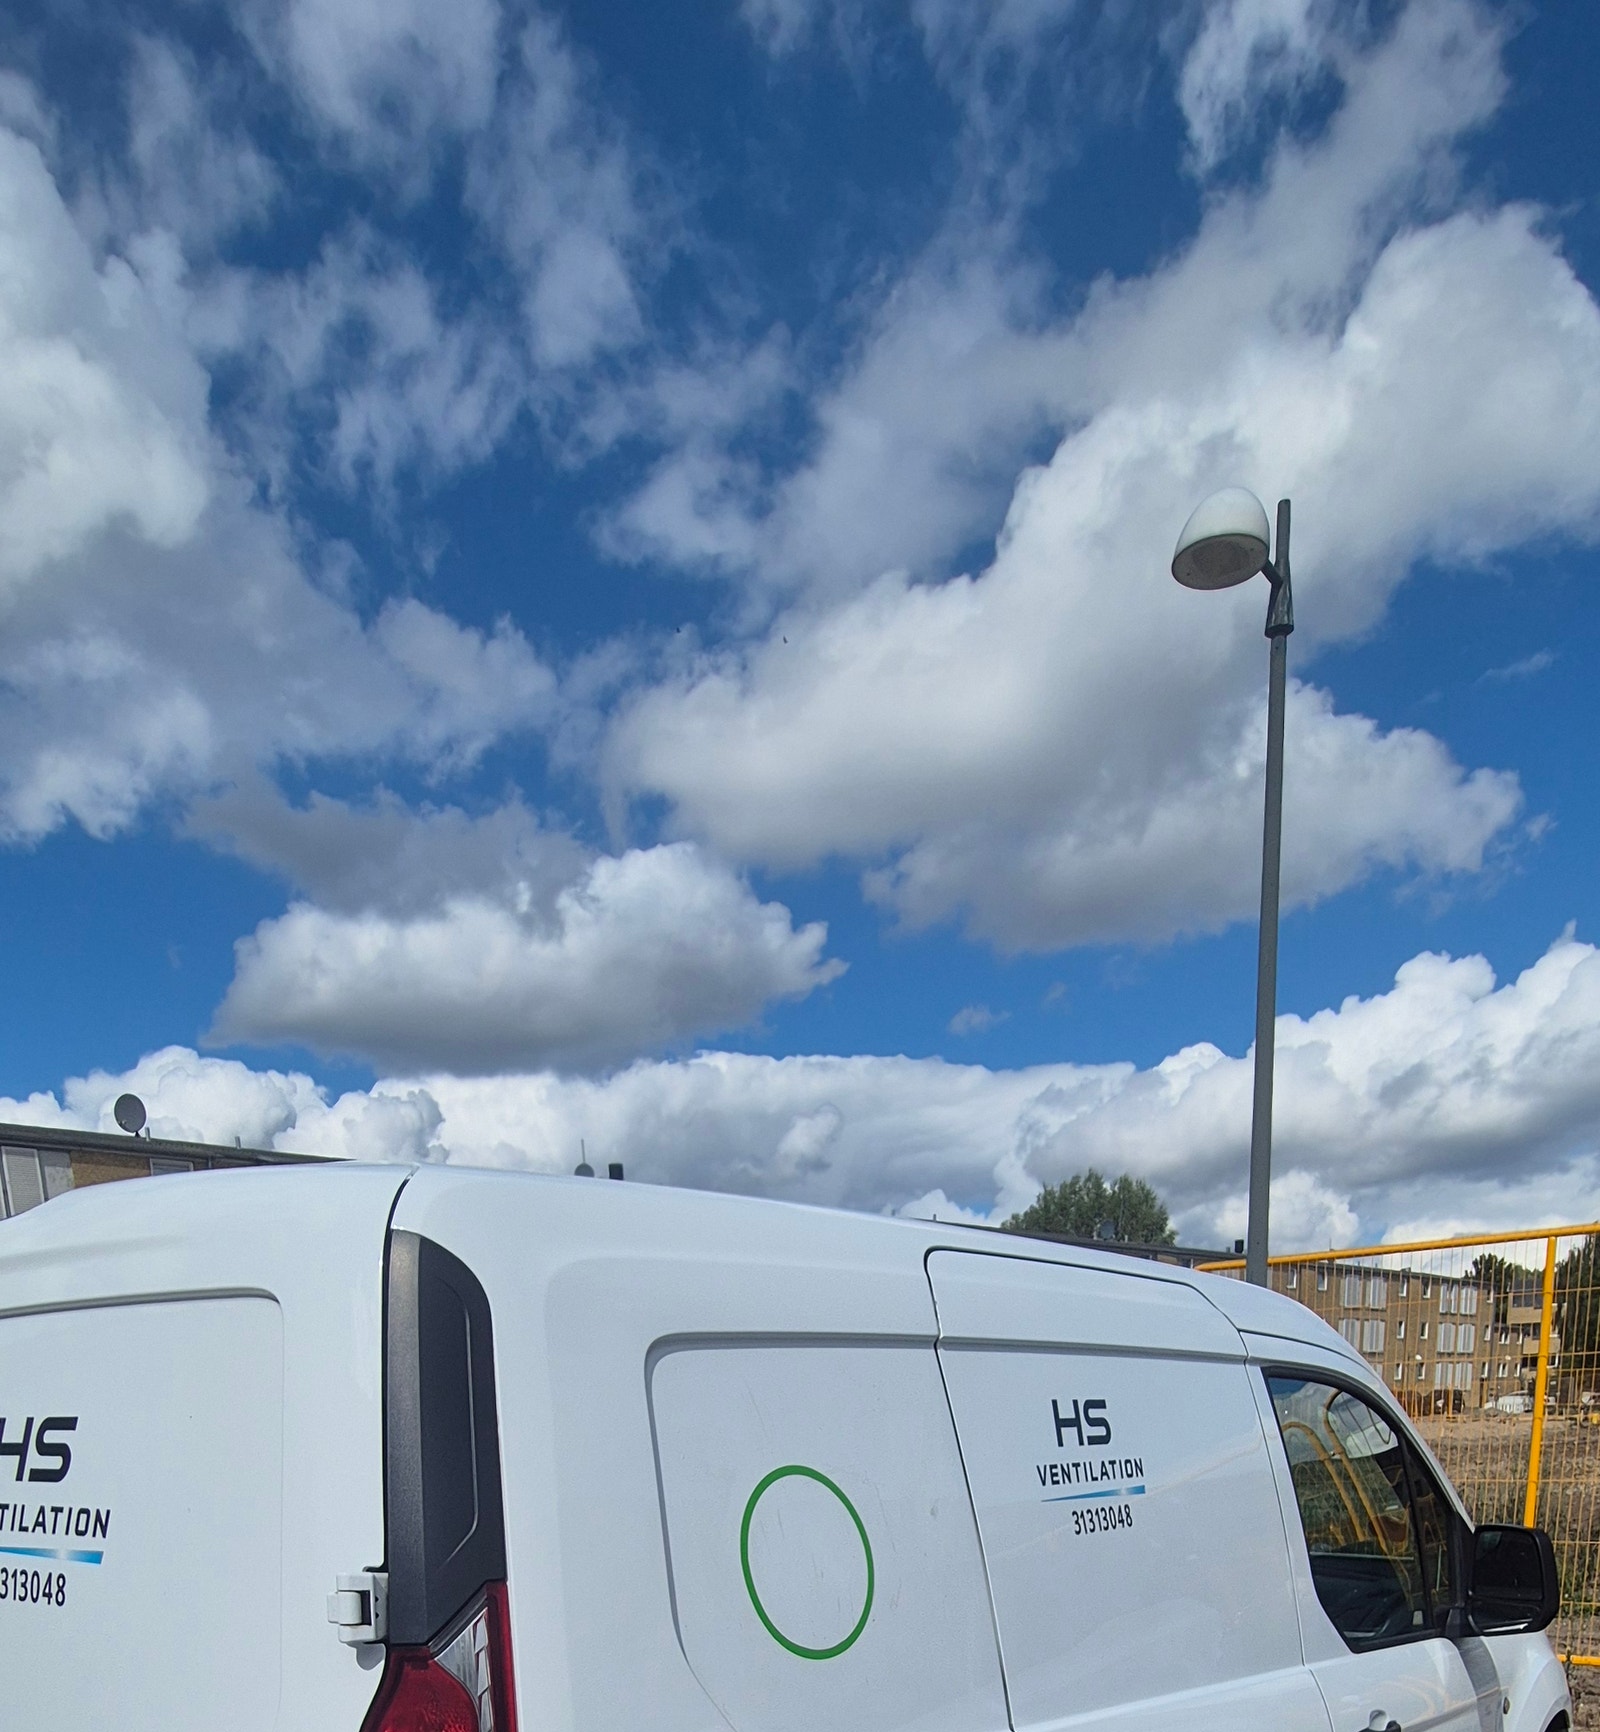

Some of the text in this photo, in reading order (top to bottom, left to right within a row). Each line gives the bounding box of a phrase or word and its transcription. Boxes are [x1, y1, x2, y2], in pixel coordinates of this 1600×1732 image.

[1051, 1399, 1112, 1447] HS
[1036, 1458, 1145, 1486] VENTILATION
[1072, 1504, 1133, 1535] 31313048
